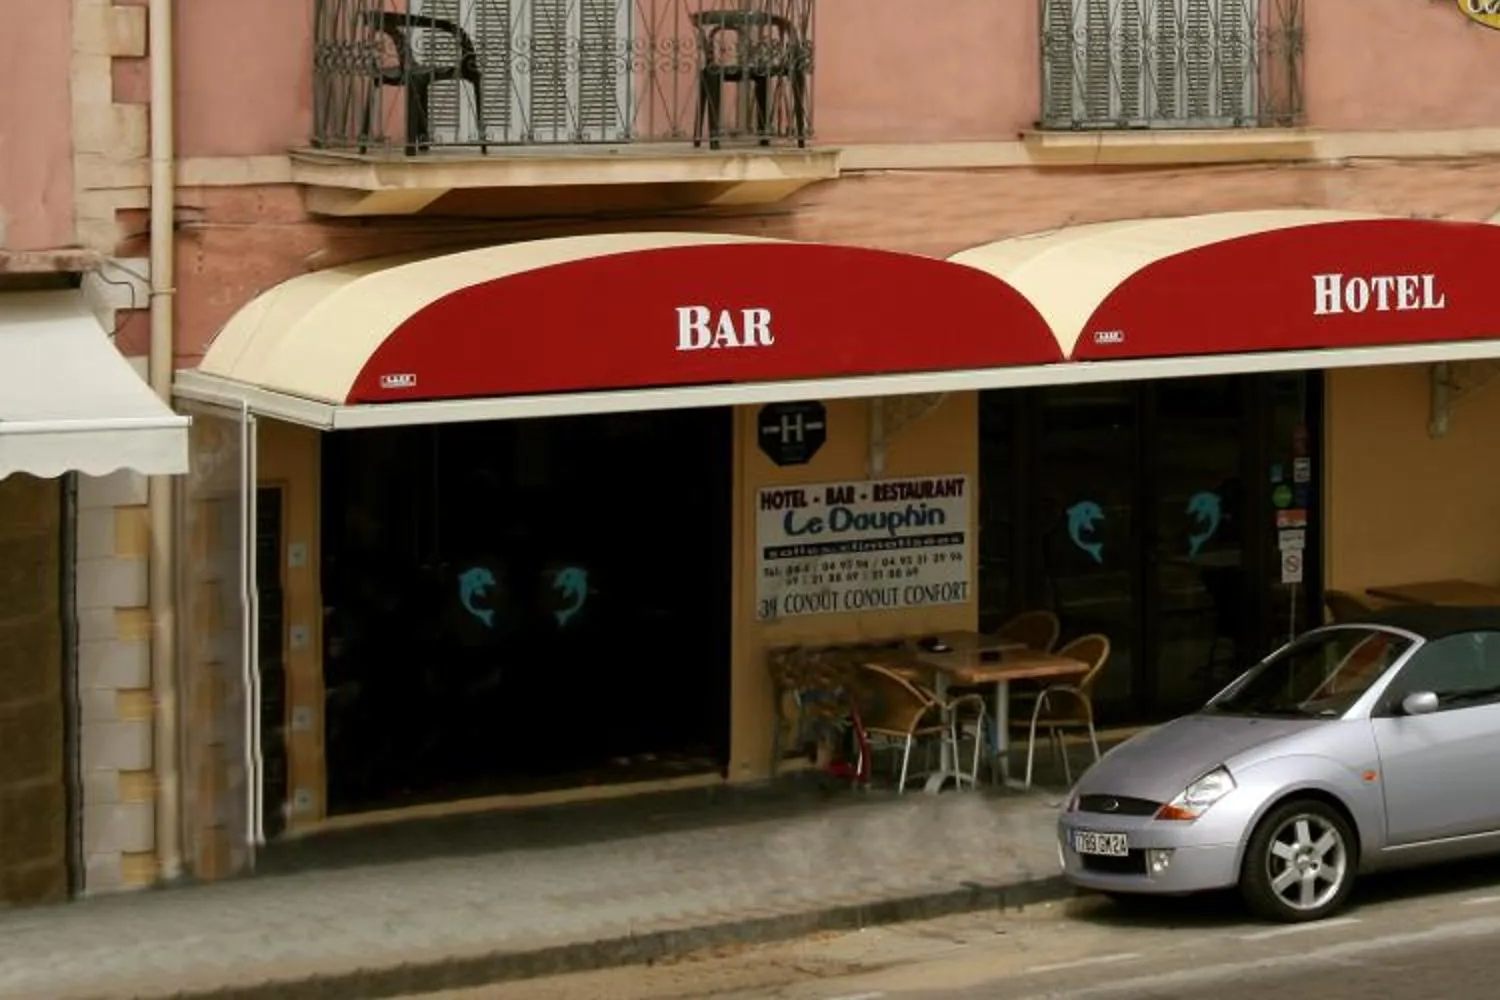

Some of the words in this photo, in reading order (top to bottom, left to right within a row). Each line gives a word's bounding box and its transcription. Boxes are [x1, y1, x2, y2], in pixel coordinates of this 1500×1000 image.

[1312, 273, 1445, 315] HOTEL
[675, 306, 775, 350] BAR
[760, 489, 808, 510] HOTEL
[825, 486, 855, 505] BAR
[873, 478, 965, 503] RESTAURANT
[783, 509, 825, 536] Le
[829, 503, 945, 536] Dauphin
